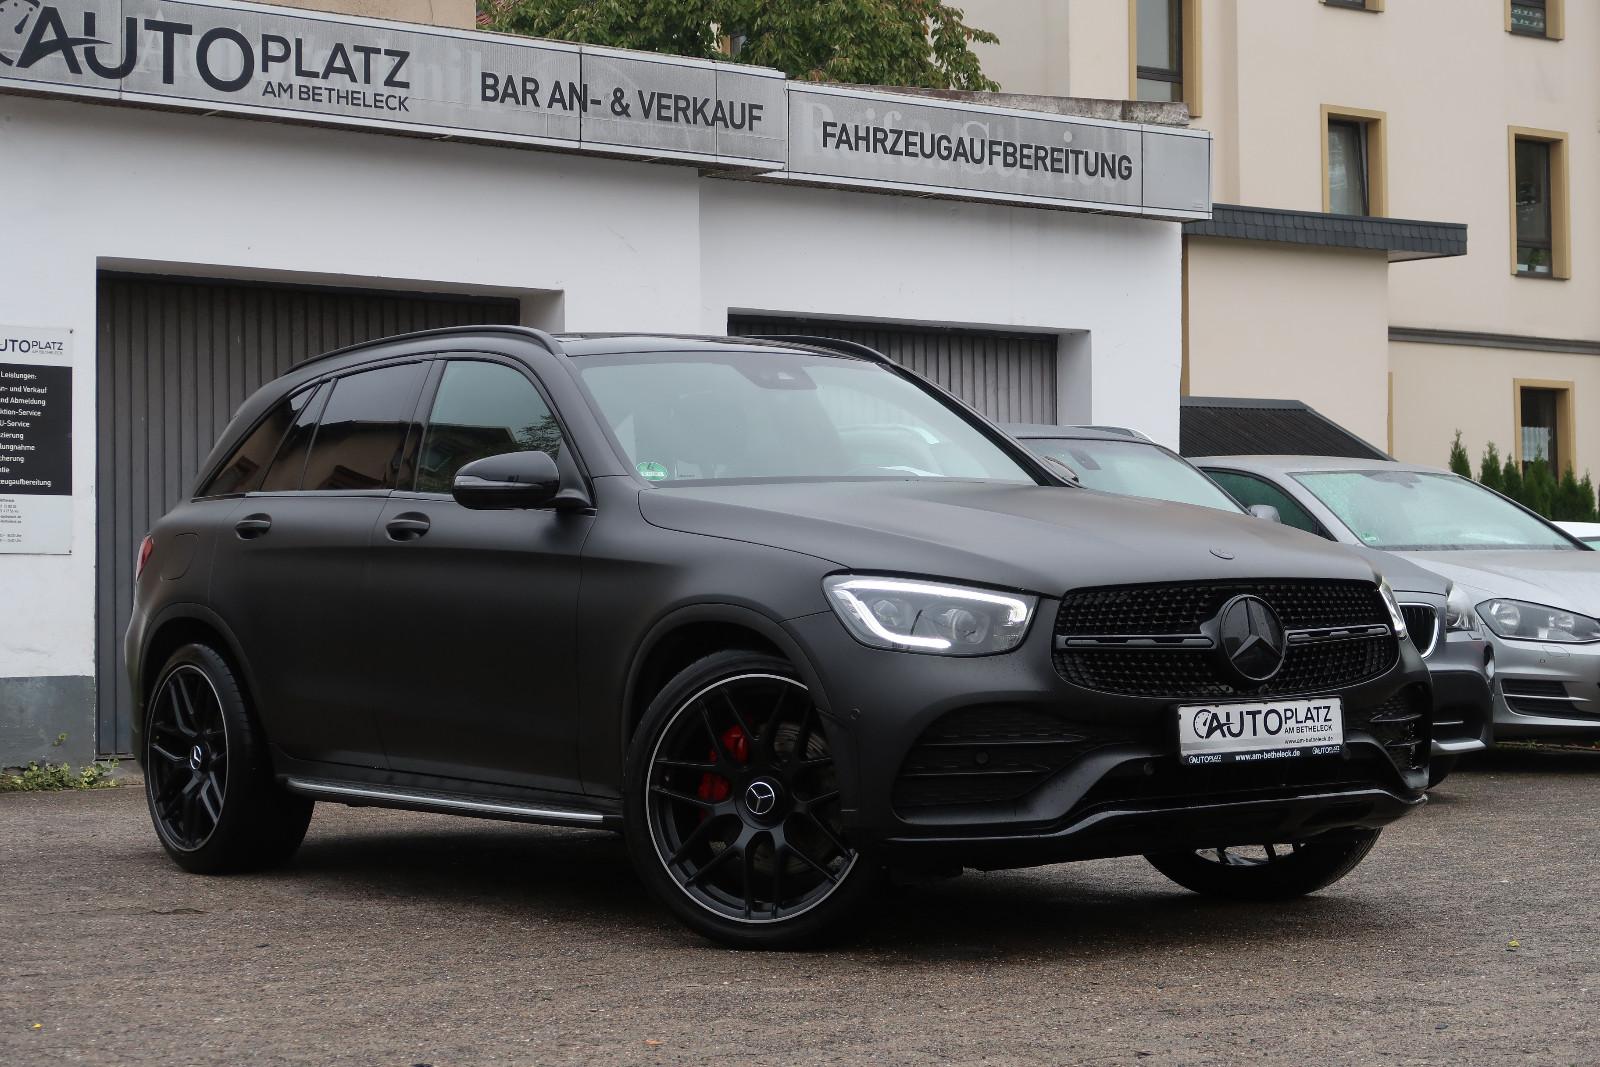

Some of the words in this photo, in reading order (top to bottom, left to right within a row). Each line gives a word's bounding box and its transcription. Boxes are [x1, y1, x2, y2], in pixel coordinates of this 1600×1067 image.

[261, 80, 293, 100] AM
[298, 84, 410, 112] BETHELECK
[481, 71, 540, 108] BAR
[547, 80, 602, 113] AN-
[610, 87, 632, 118] &
[637, 89, 764, 132] VERKAUF
[822, 121, 1133, 181] FAHRZEUGAUFBEREITUNG
[23, 385, 47, 394] Verkauf
[10, 397, 46, 406] Abmeldung
[1284, 726, 1295, 734] AM
[1296, 724, 1333, 733] BETHELECK
[1235, 750, 1301, 762] www.am-betheleck.de
